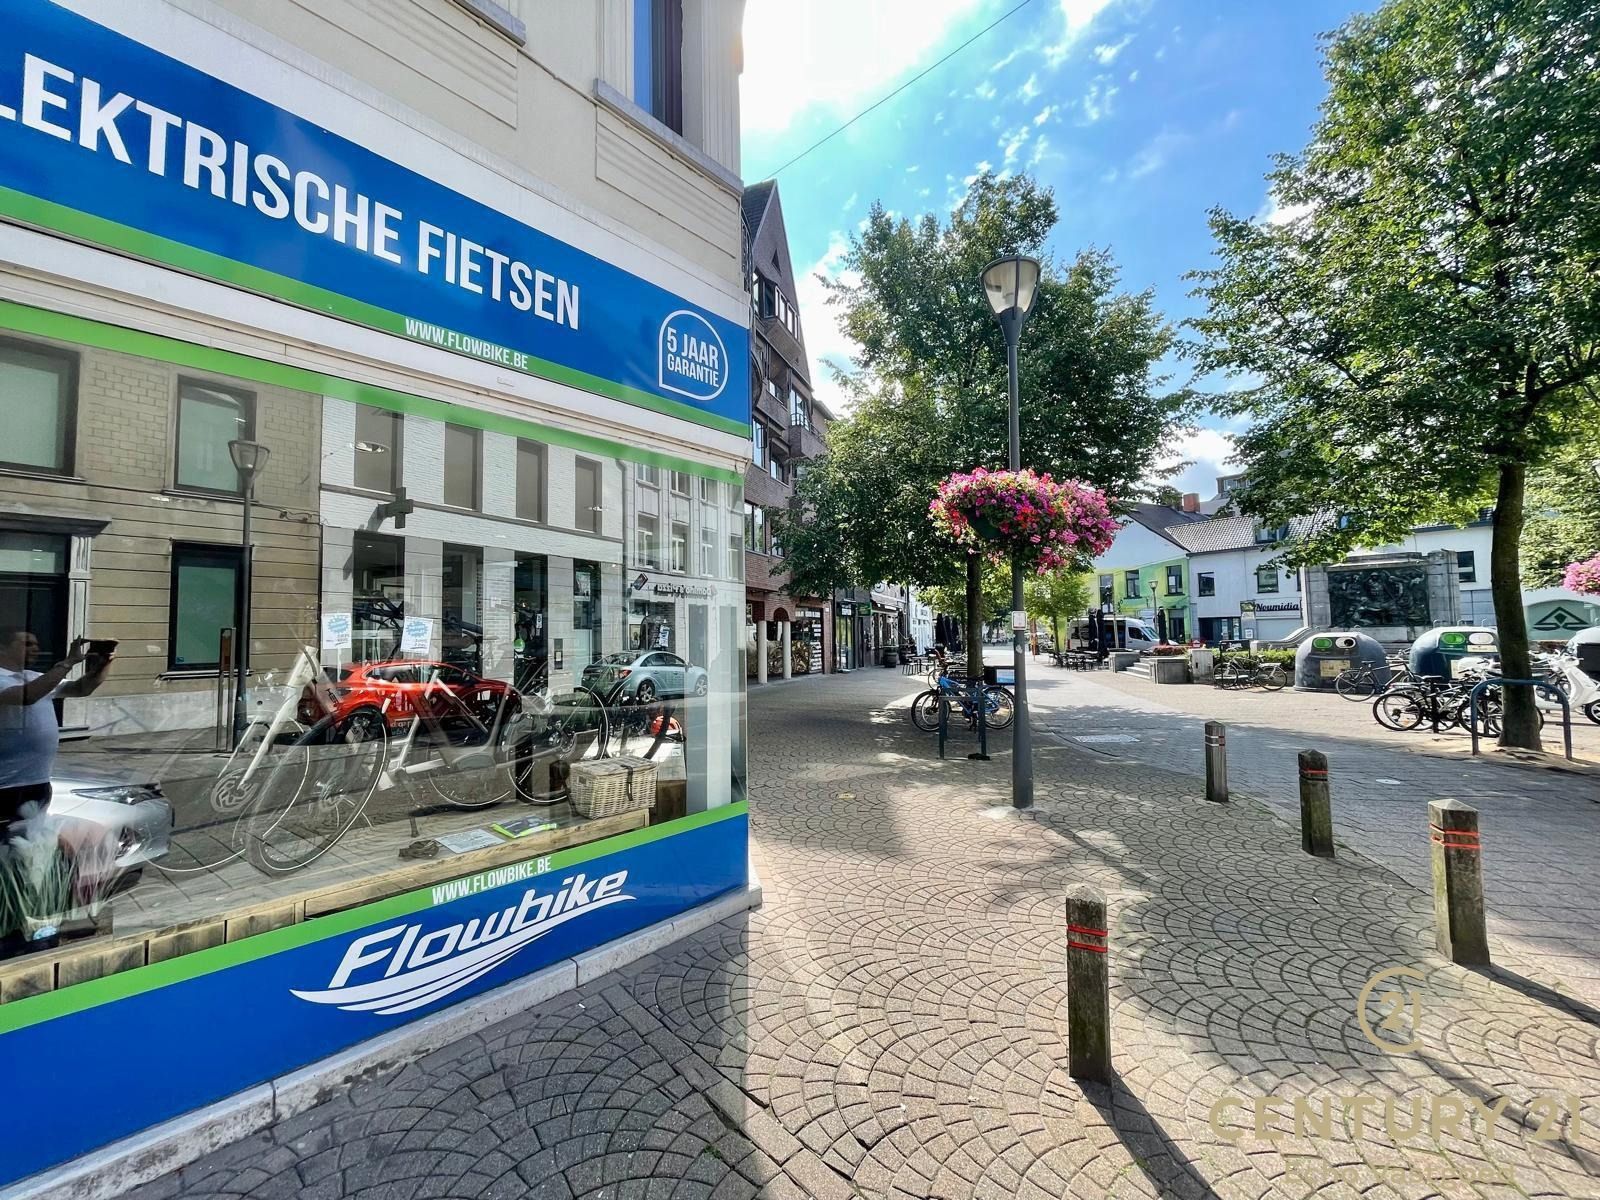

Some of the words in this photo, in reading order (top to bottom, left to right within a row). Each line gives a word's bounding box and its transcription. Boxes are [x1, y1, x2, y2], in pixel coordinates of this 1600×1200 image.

[0, 53, 403, 265] EKTRISCHE
[417, 220, 580, 331] FIETSEN
[404, 316, 529, 370] WWW.FLOWBIKE.BE
[666, 326, 678, 353] 5
[681, 333, 719, 369] JAAR
[667, 353, 719, 388] GARANTIE
[1256, 602, 1300, 612] Noumidia
[431, 856, 553, 906] WWW.FLOWBIKE.BE
[327, 869, 629, 990] Flowbike
